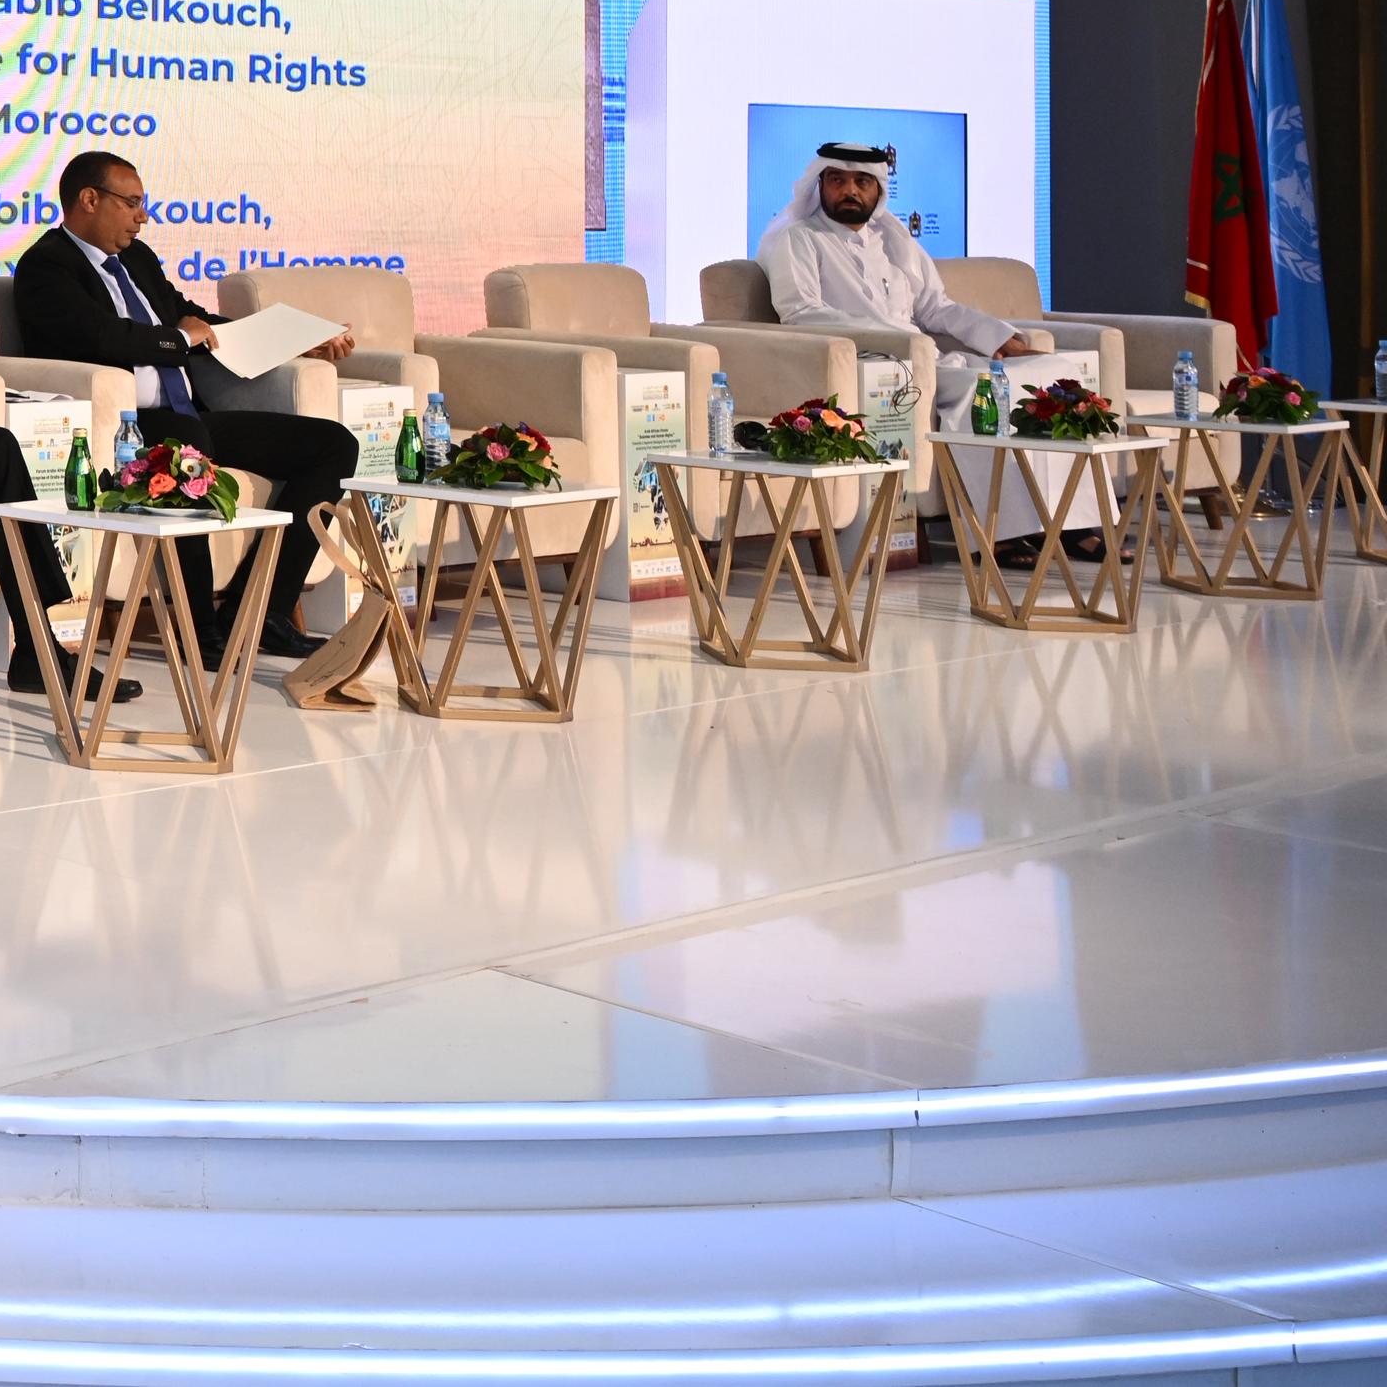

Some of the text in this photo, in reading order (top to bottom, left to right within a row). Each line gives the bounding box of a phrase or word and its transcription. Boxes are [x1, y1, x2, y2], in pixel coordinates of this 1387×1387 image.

[16, 41, 77, 76] for
[90, 47, 235, 82] Human
[248, 52, 367, 93] Rights
[177, 251, 226, 281] de
